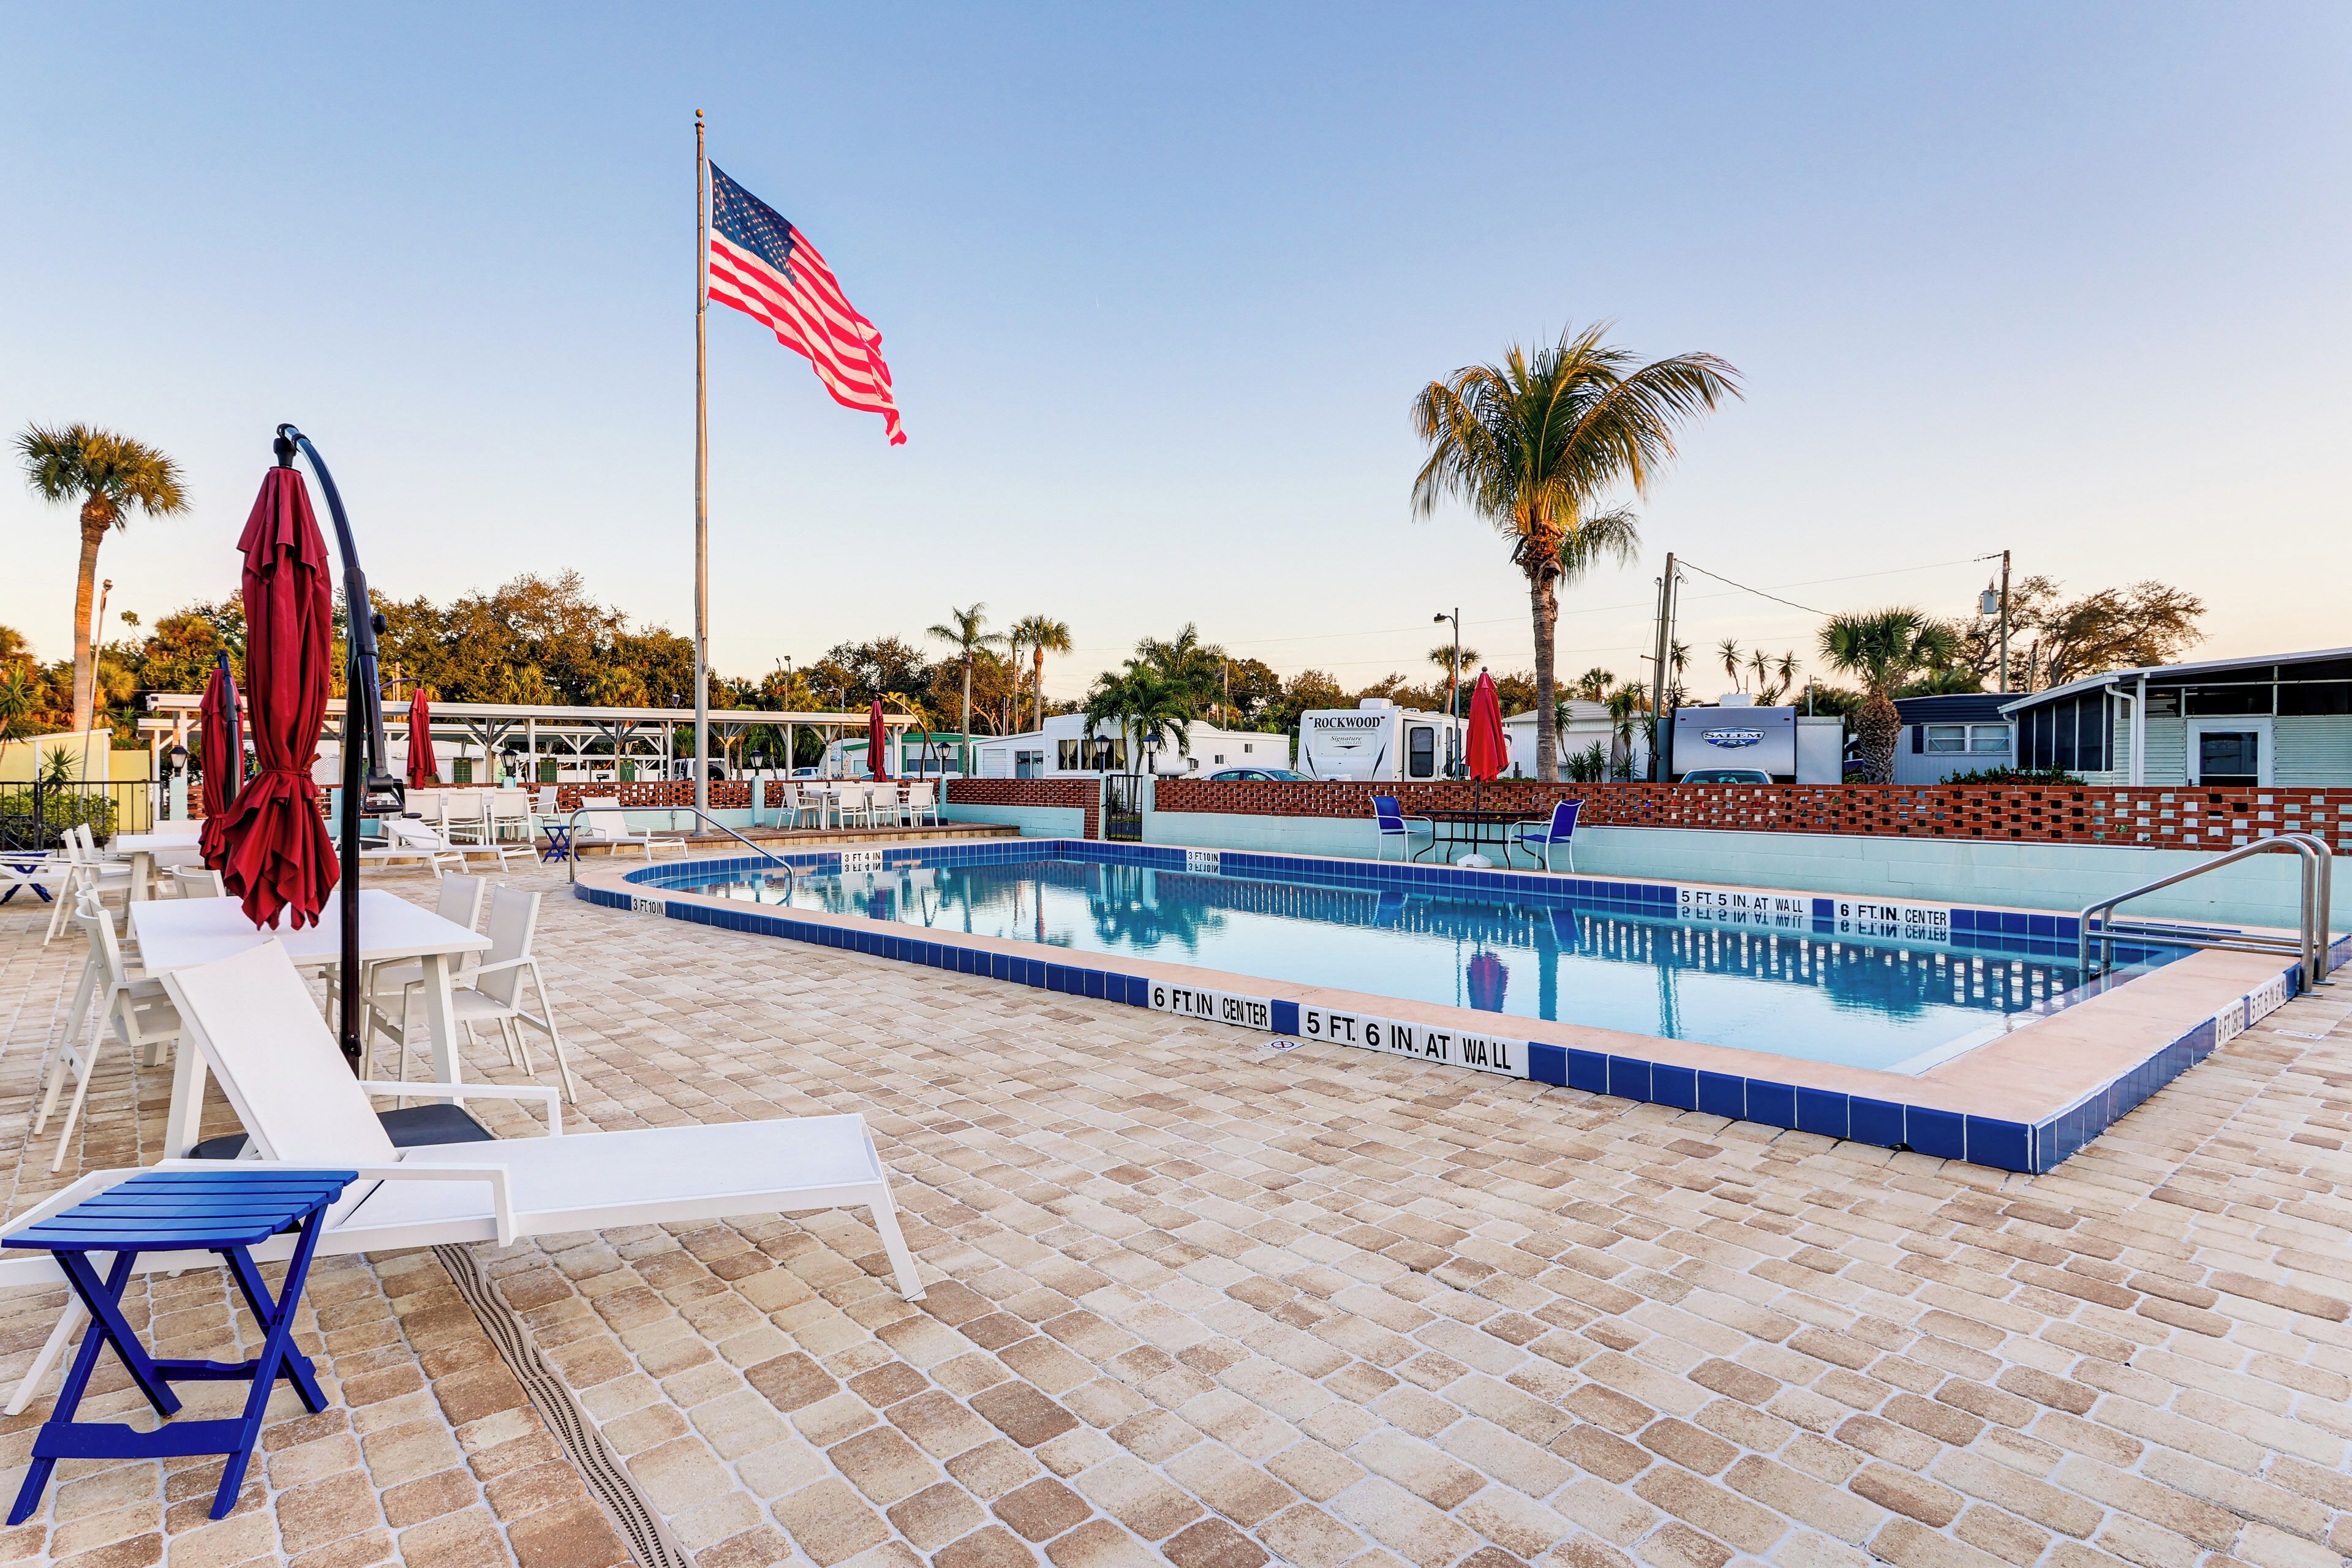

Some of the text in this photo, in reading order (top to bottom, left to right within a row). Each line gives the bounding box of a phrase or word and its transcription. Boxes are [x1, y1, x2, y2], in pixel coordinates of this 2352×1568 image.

[1313, 717, 1380, 728] ROCKWOOD
[845, 854, 849, 862] 3
[1203, 853, 1210, 861] 10
[633, 899, 638, 910] 3
[649, 901, 656, 914] 10
[1681, 891, 1803, 913] 5 FT. 5 IN. AT WALL
[1841, 904, 1946, 925] 6 FT. IN. CENTER
[1155, 987, 1268, 1027] 6 FT. IN CENTER
[1307, 1011, 1511, 1070] 5 FT. 6 IN. AT WALL
